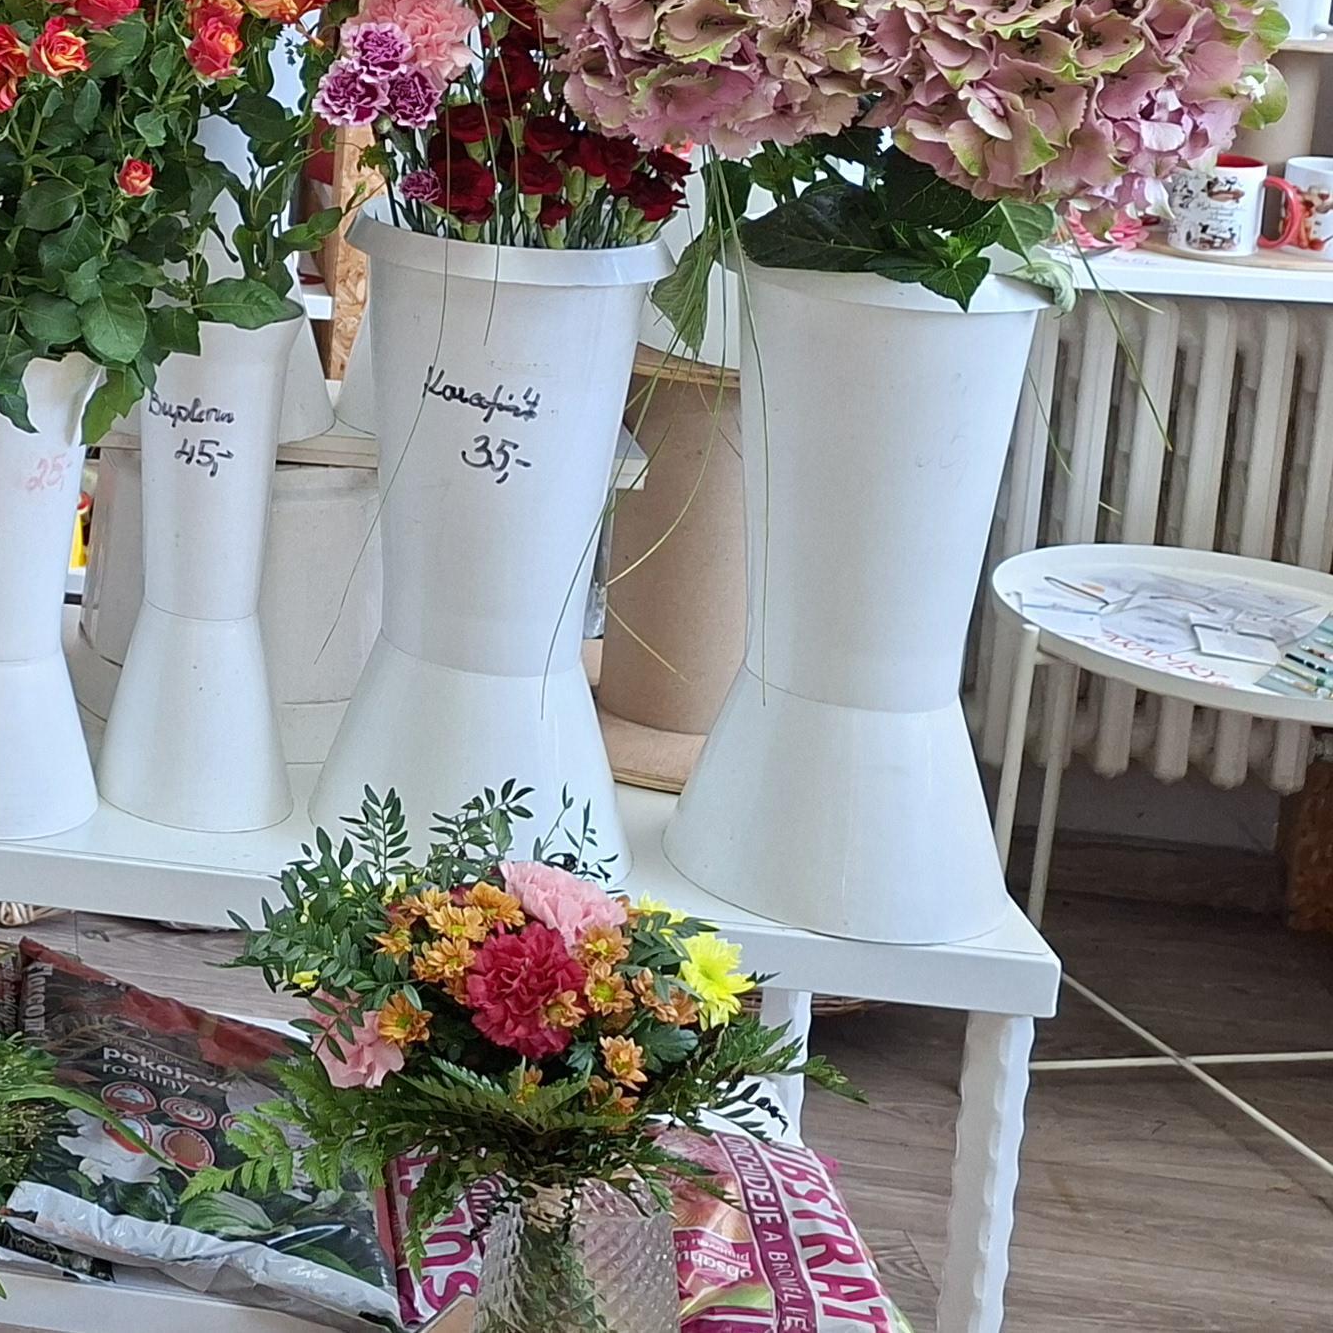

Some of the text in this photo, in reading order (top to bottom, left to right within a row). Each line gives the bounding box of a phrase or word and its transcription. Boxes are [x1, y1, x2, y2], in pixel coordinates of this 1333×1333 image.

[174, 438, 235, 478] 45,-
[461, 434, 532, 484] 35,-
[102, 1046, 234, 1092] pokojové
[102, 1063, 191, 1095] rostliny
[721, 1135, 783, 1225] ORCHIDEJE
[761, 1229, 783, 1242] A
